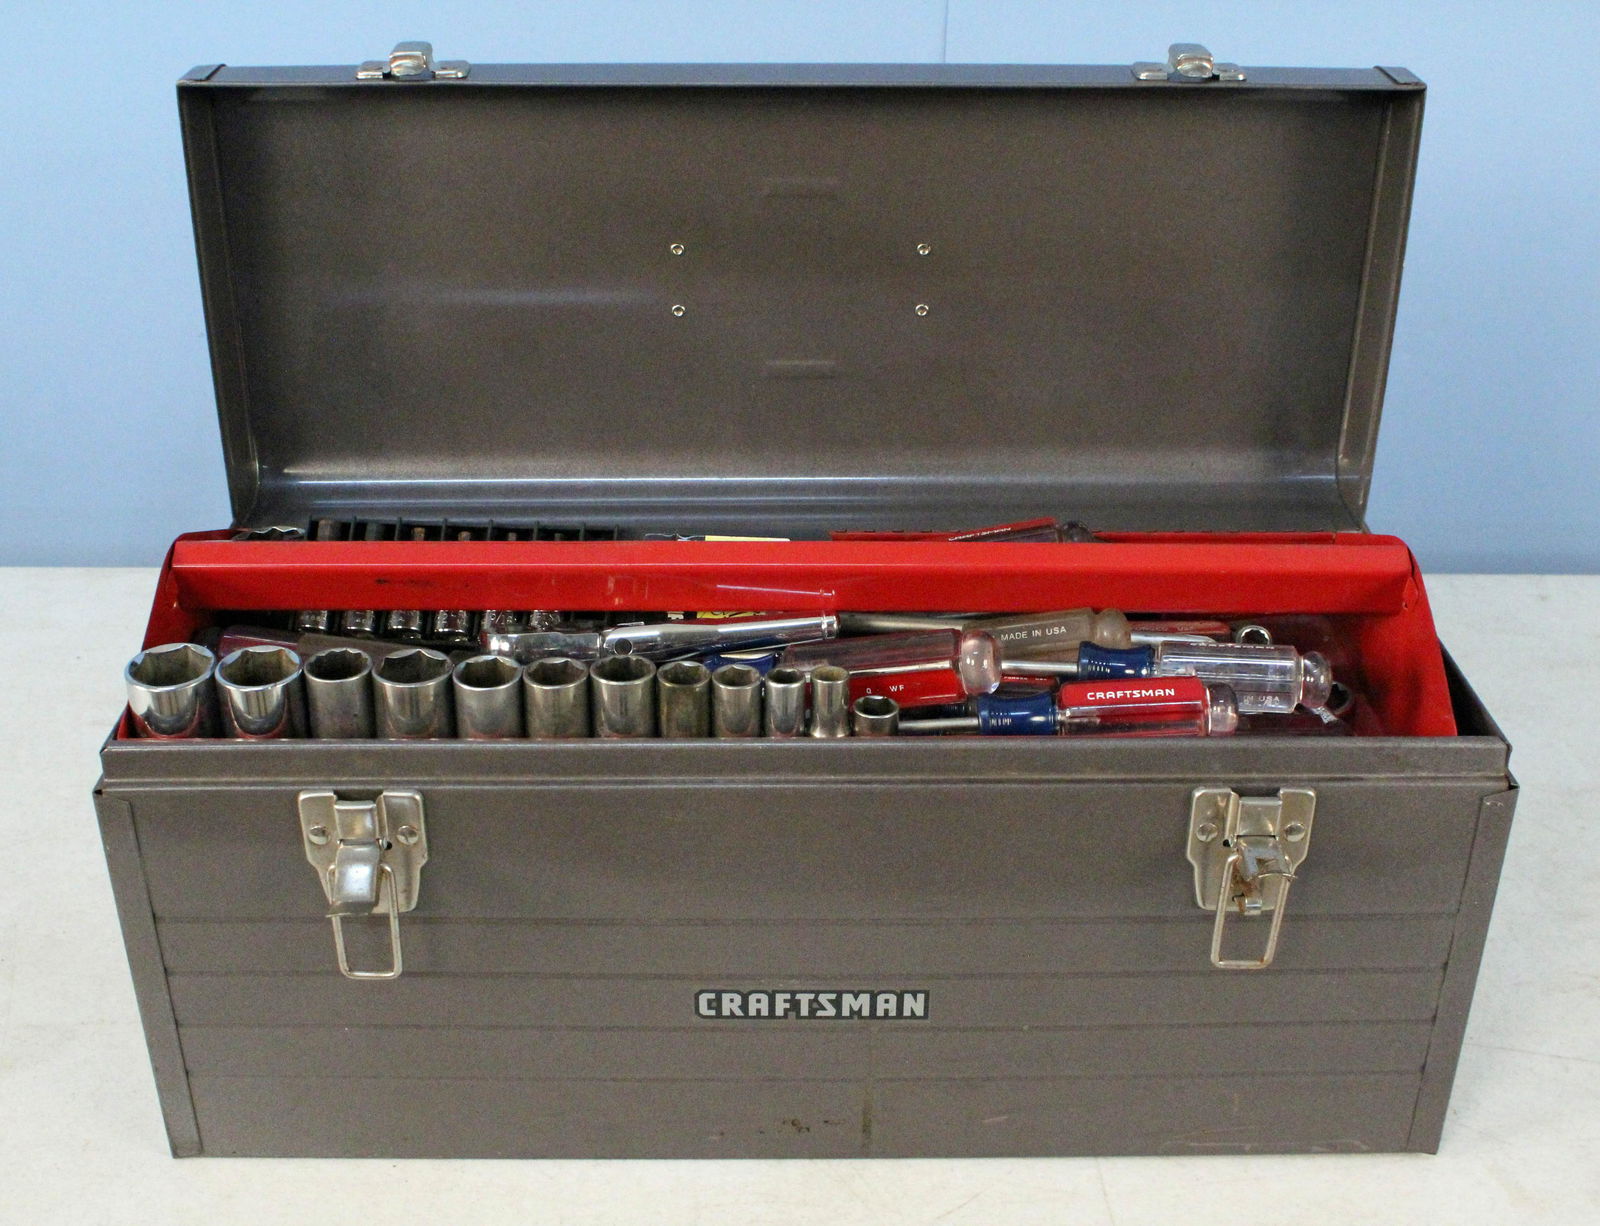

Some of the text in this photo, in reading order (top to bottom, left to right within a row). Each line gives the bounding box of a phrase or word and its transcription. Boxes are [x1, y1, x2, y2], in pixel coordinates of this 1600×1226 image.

[1001, 626, 1067, 641] MADE IN USA
[1087, 688, 1175, 700] CRAFTSMAN
[698, 992, 926, 1017] CRAFTSMAN
